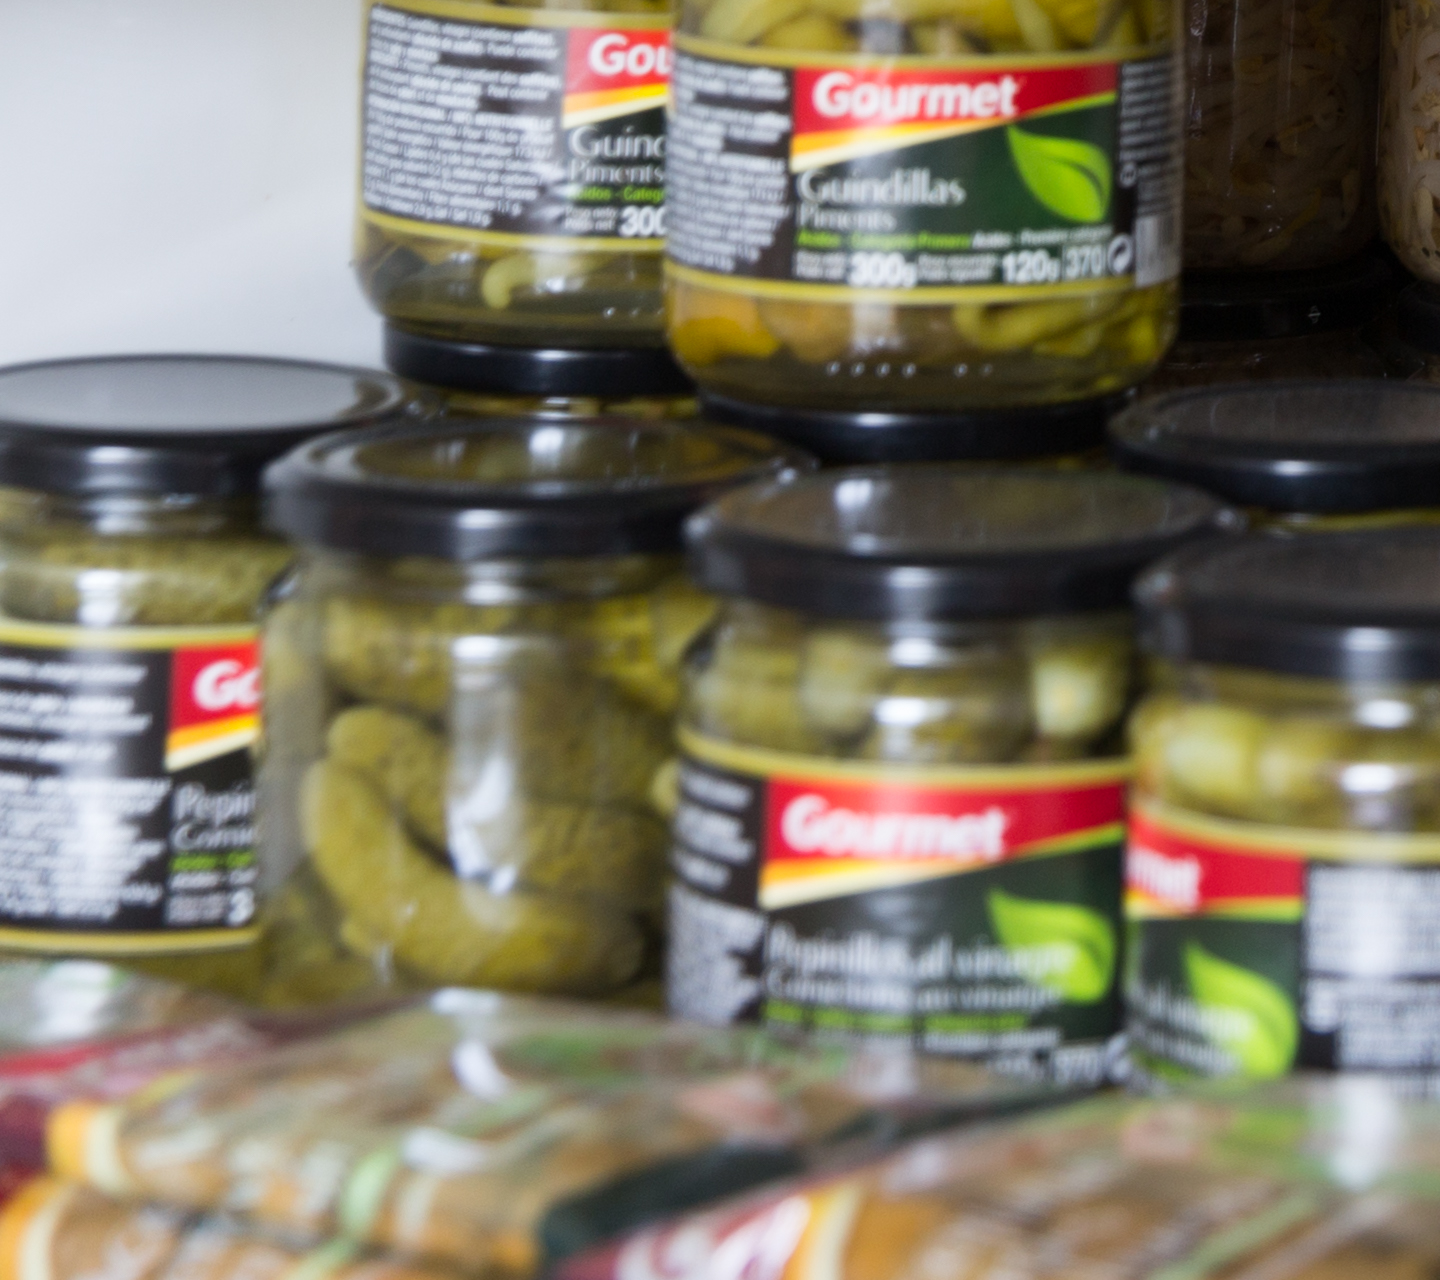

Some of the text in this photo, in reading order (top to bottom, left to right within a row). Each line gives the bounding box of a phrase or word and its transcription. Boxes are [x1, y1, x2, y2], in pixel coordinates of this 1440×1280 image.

[813, 71, 1019, 119] Gourmet
[799, 167, 966, 207] Guindillas
[799, 205, 897, 234] Piments
[1002, 250, 1060, 285] 120g
[1066, 247, 1104, 278] 370
[782, 794, 1008, 862] Gourmet
